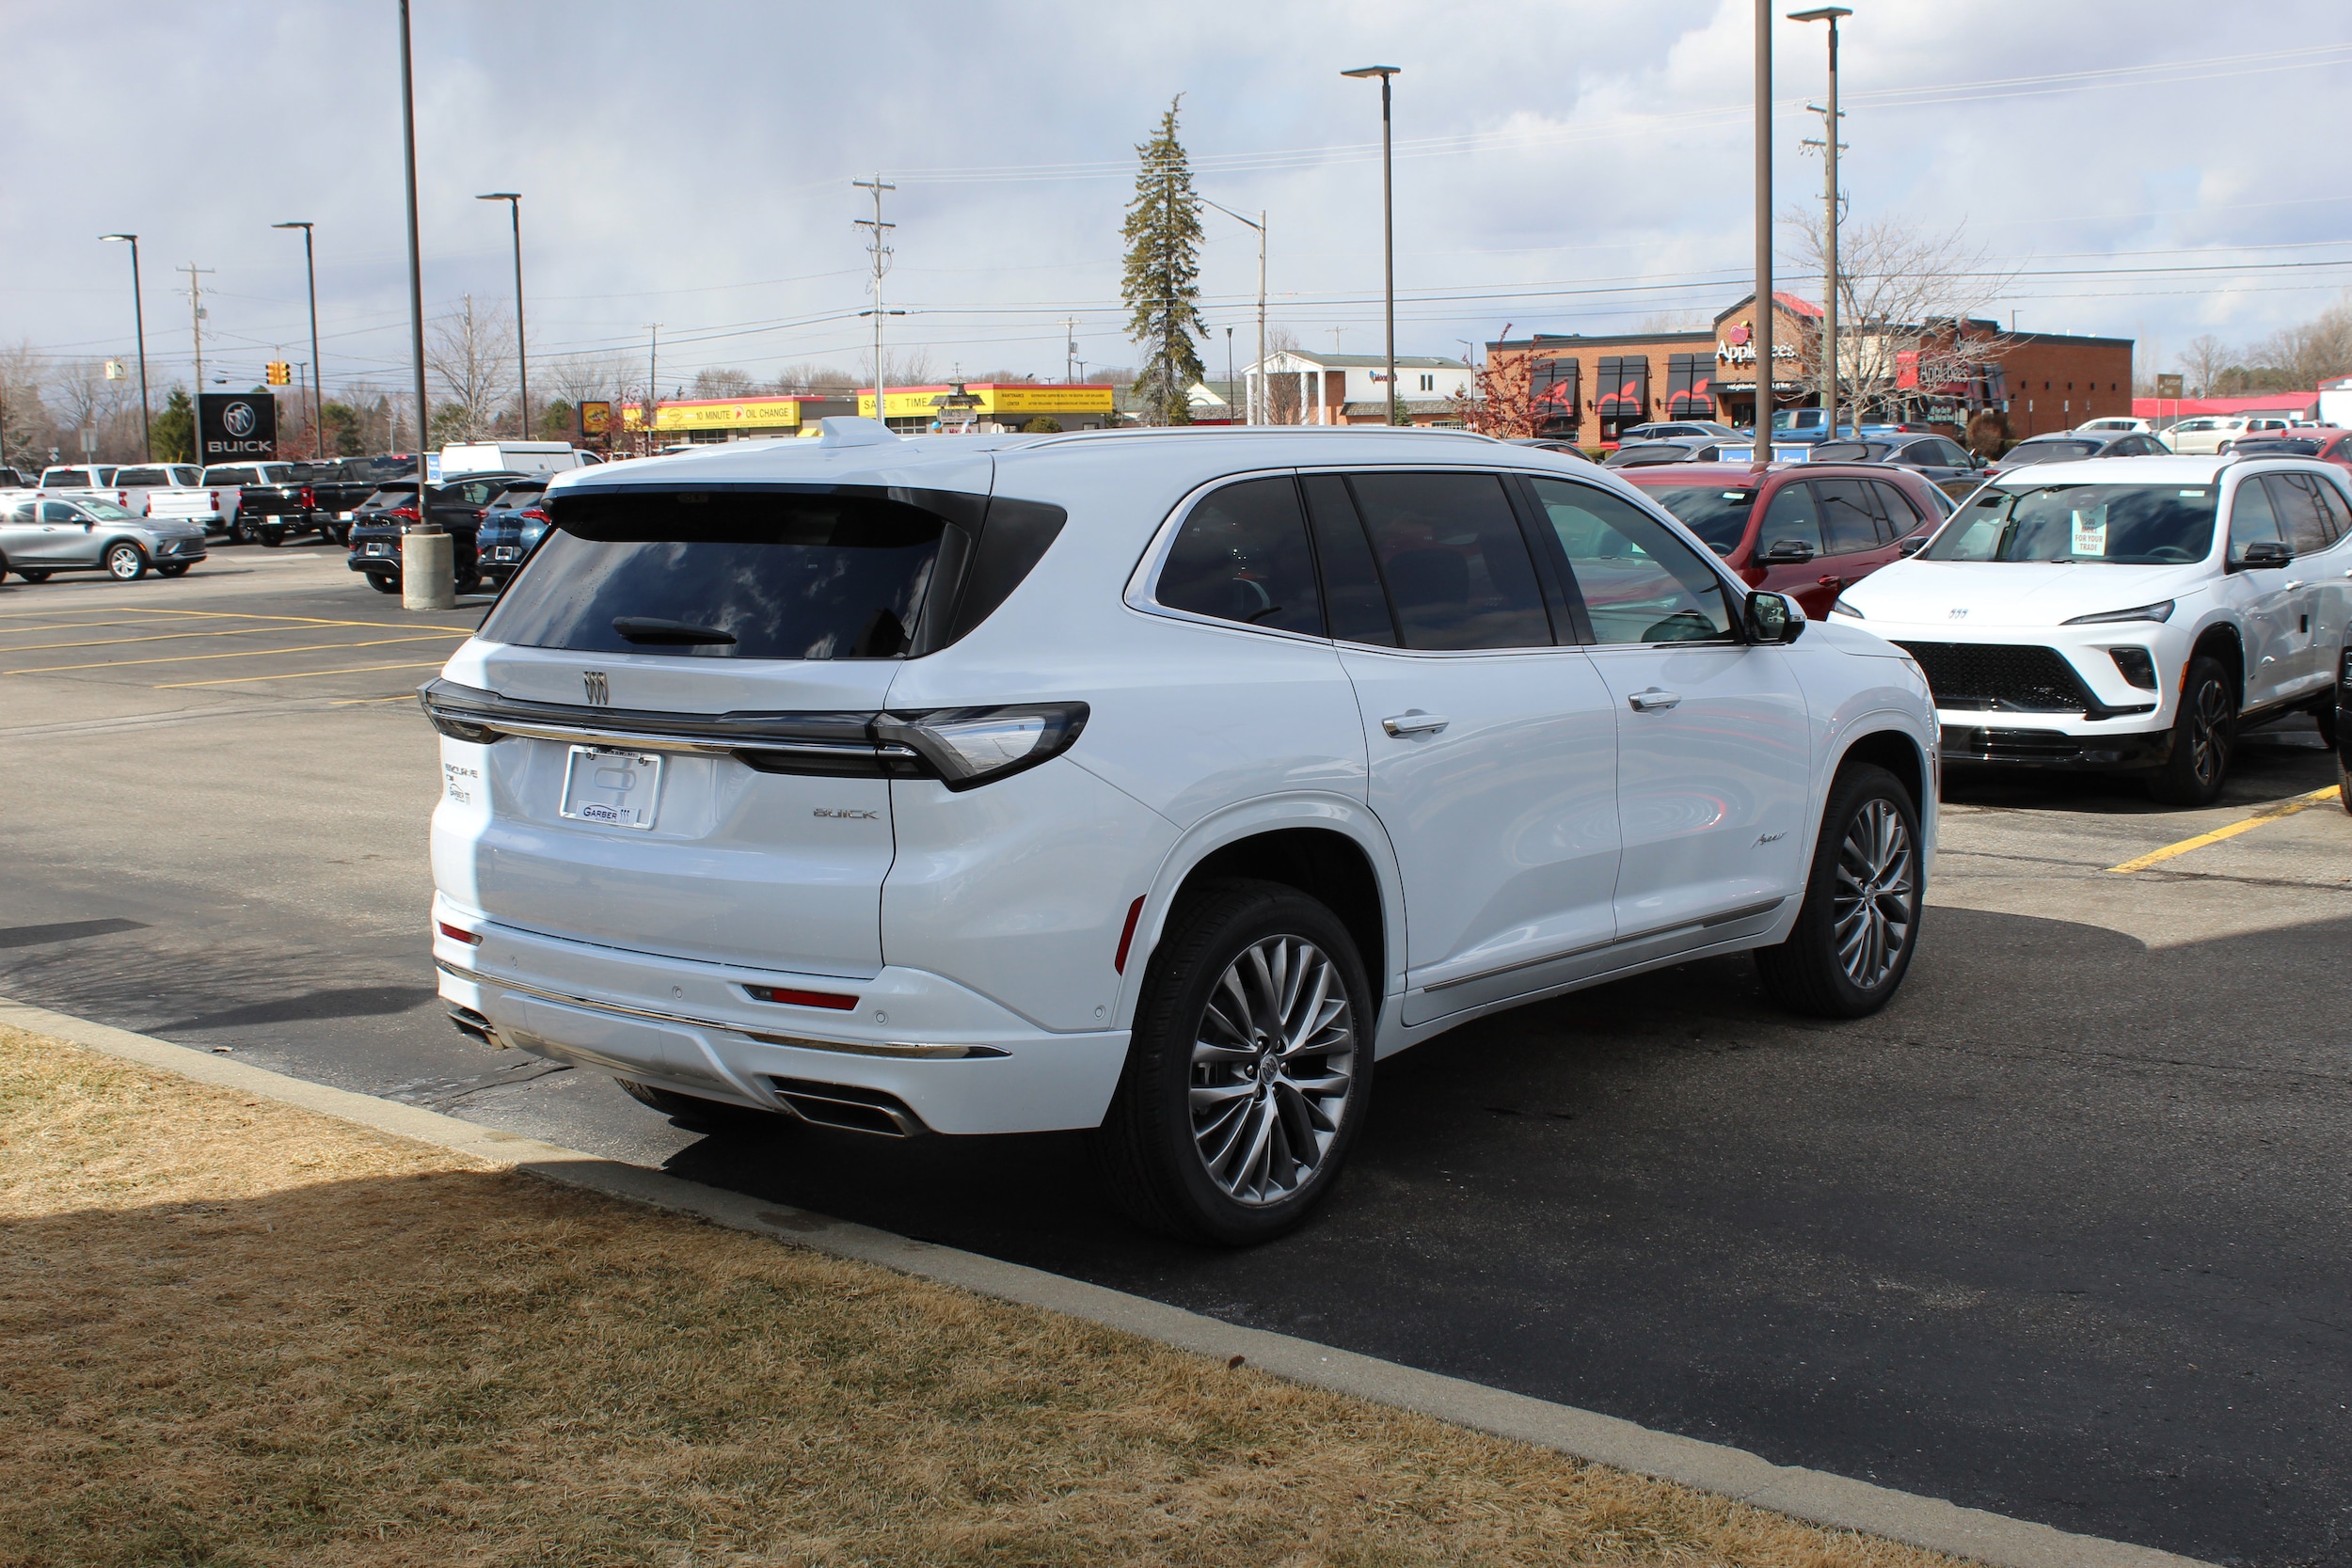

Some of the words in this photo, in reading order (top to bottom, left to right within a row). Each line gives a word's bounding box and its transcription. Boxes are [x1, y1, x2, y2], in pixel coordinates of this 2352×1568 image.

[864, 399, 886, 410] SAE
[905, 397, 928, 407] TIME
[695, 412, 704, 420] 10
[705, 410, 730, 420] MINUTE
[746, 409, 756, 419] OIL
[759, 407, 788, 418] CHANGE
[207, 440, 273, 452] BUICK
[2079, 543, 2098, 551] TRADE
[583, 806, 617, 820] GARBER
[813, 808, 880, 819] BUICK
